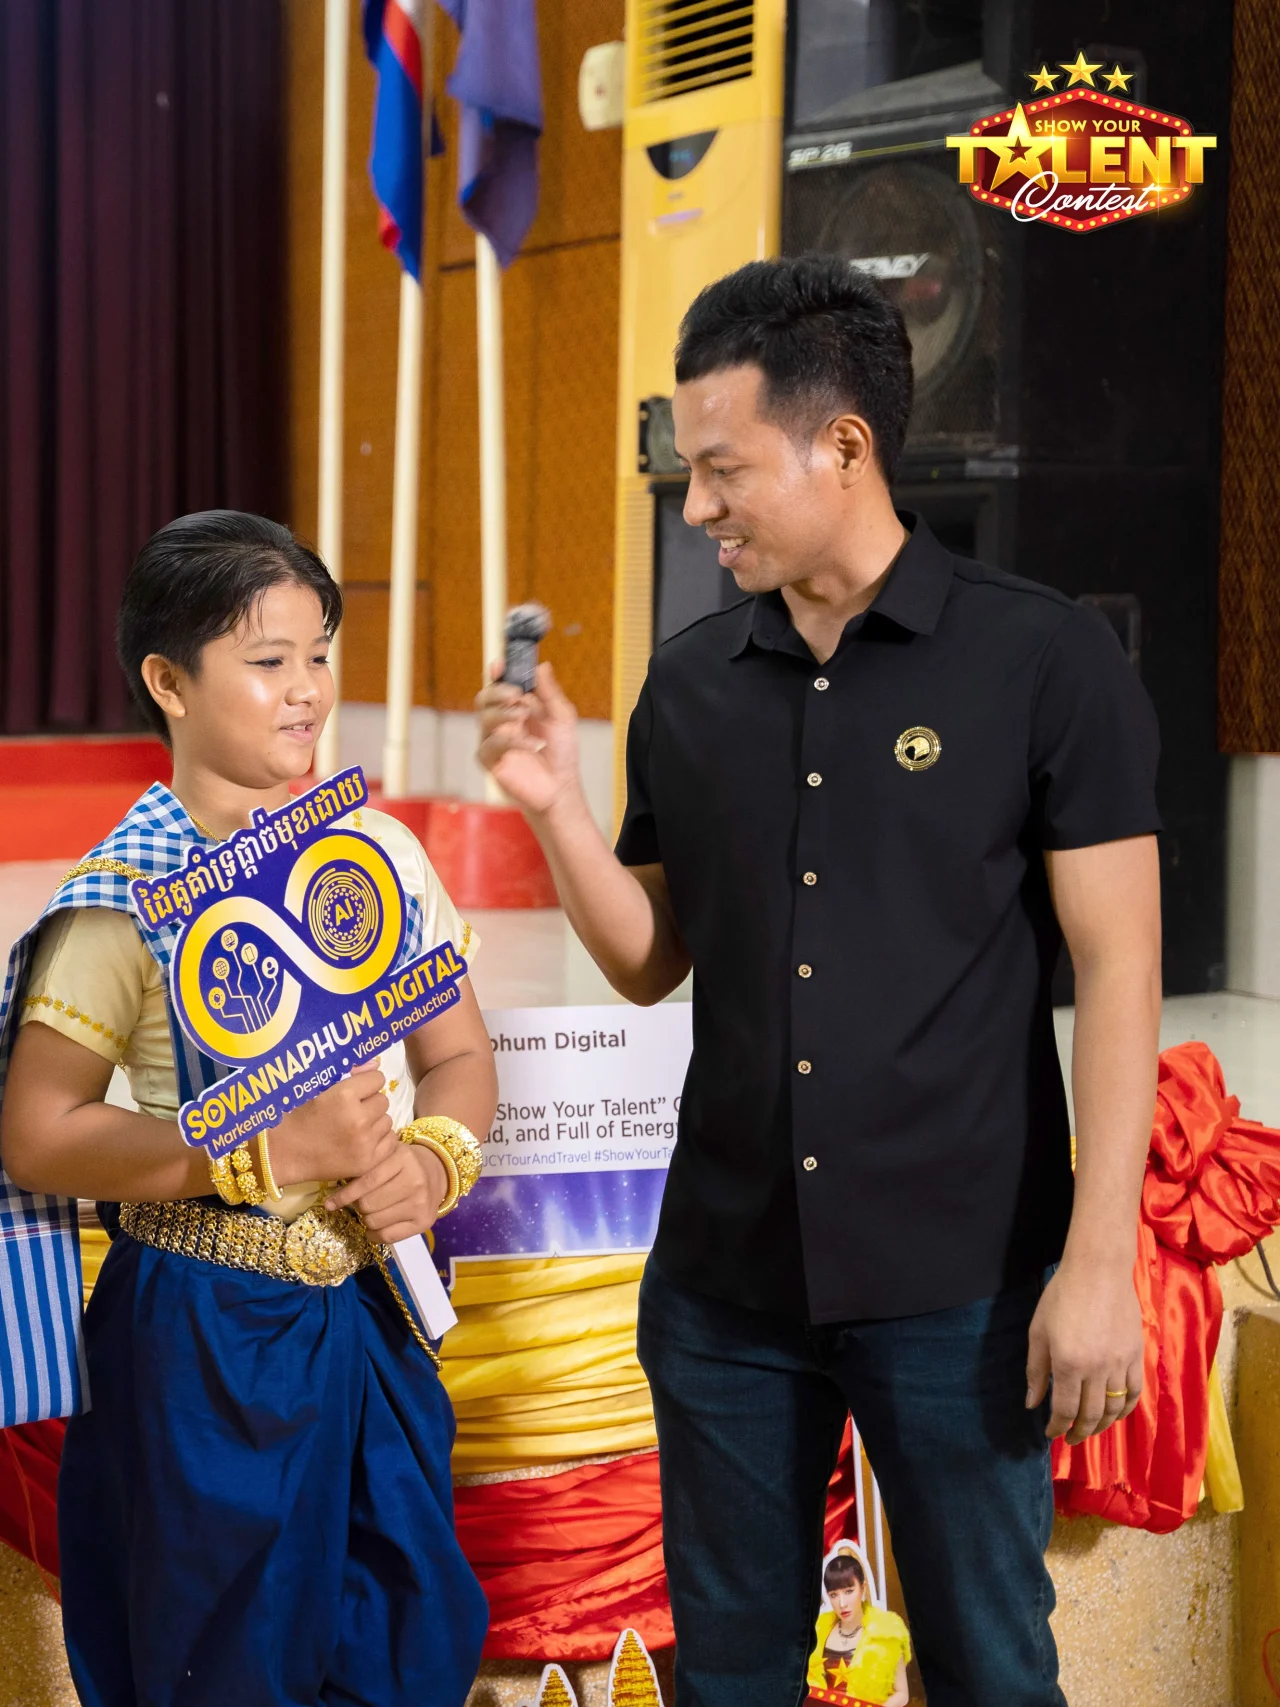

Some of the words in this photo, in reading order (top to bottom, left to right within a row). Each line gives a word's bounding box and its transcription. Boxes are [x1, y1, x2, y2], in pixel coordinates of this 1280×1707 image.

[334, 899, 354, 926] AI
[186, 1001, 373, 1140] SOVANNAPHUM
[375, 947, 463, 1020] DIGITAL
[555, 1030, 626, 1051] Digital
[211, 1103, 277, 1152] Marketing
[293, 1063, 337, 1100] Design
[353, 1031, 390, 1060] Video
[391, 986, 457, 1036] Production
[553, 1101, 595, 1119] Your
[516, 1124, 549, 1142] and
[557, 1121, 590, 1140] Full
[596, 1119, 615, 1138] of
[621, 1120, 678, 1139] Energ
